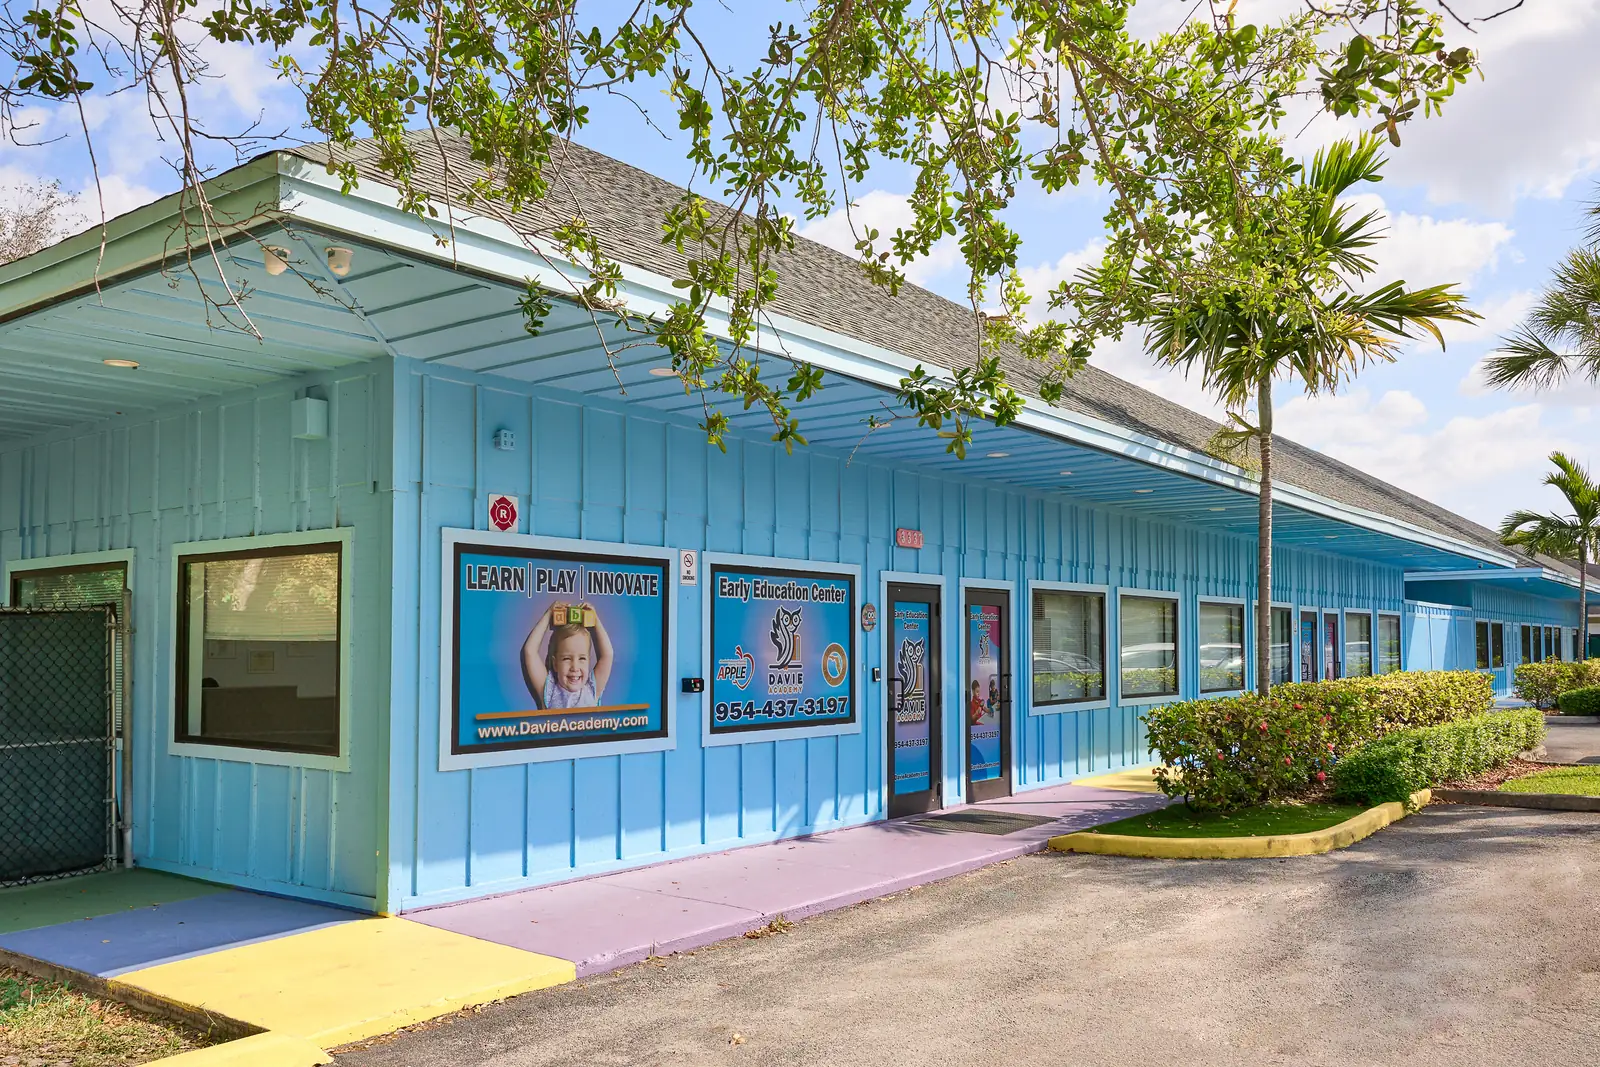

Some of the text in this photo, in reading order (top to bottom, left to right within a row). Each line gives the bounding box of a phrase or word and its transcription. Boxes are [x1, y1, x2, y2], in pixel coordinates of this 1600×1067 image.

[500, 509, 507, 519] R
[466, 564, 659, 597] LEARN PLAY INNOVATE
[719, 577, 846, 603] Early Education Center
[716, 665, 747, 680] APPLE
[768, 673, 803, 685] DAVIE
[768, 686, 803, 694] ACADEMY
[715, 697, 848, 721] 954-437-3197
[478, 714, 649, 738] www.DavieAcademy.com
